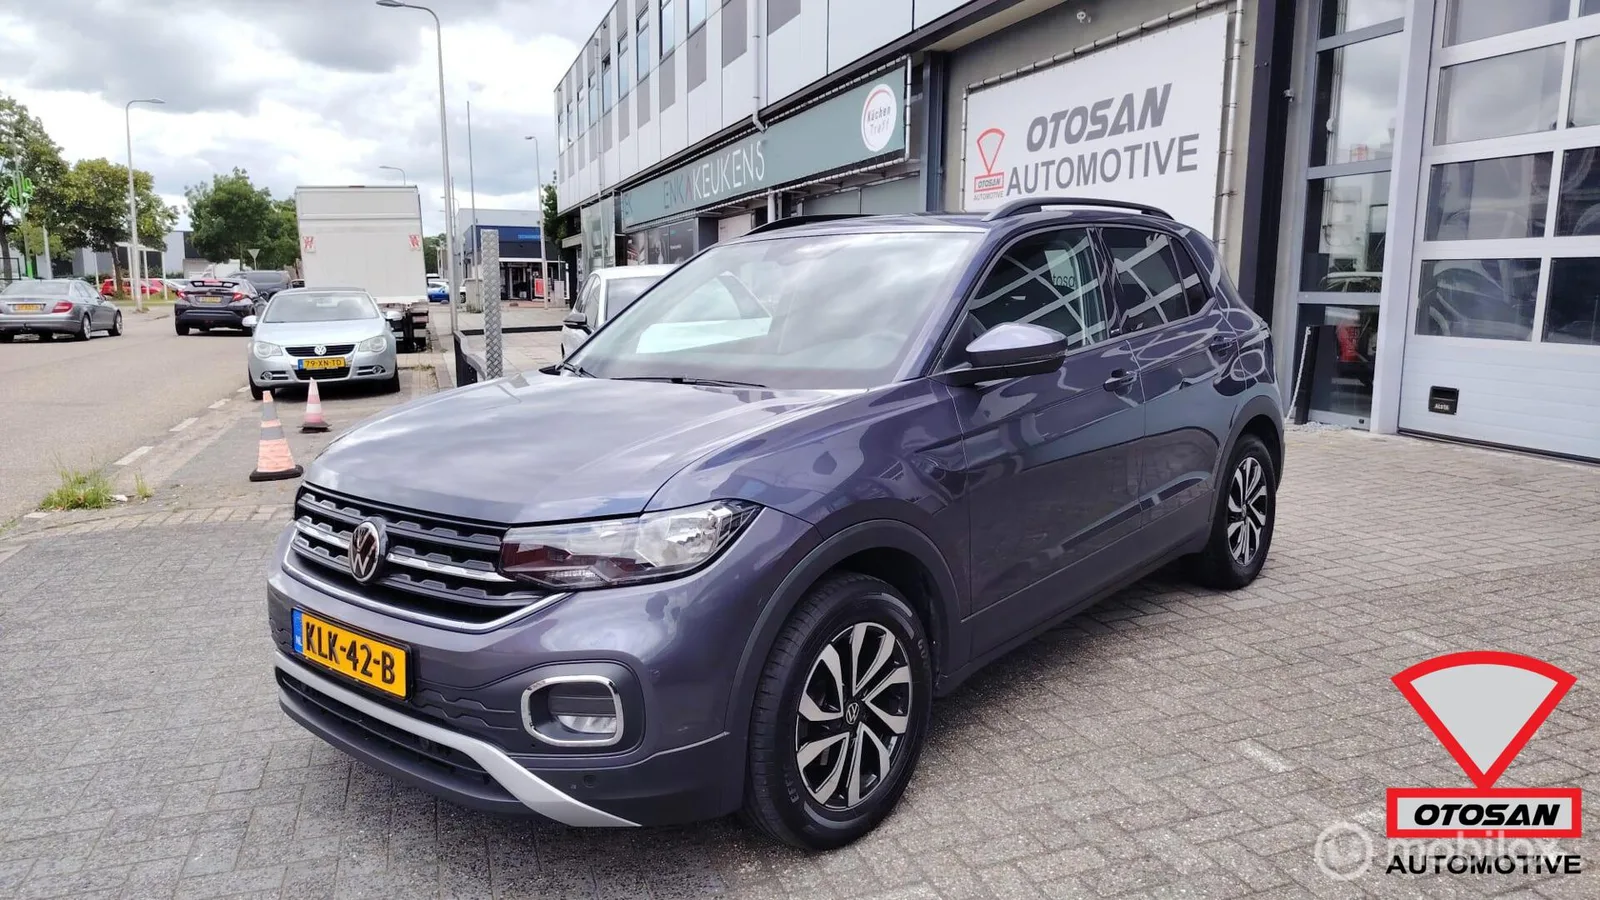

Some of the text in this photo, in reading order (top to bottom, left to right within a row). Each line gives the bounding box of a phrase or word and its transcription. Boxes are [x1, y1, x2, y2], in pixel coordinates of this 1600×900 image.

[1027, 83, 1172, 153] OTOSAN
[977, 178, 1001, 189] OTOSAN
[1006, 133, 1200, 197] AUTOMOTIVE
[305, 620, 396, 685] KLK-42-B
